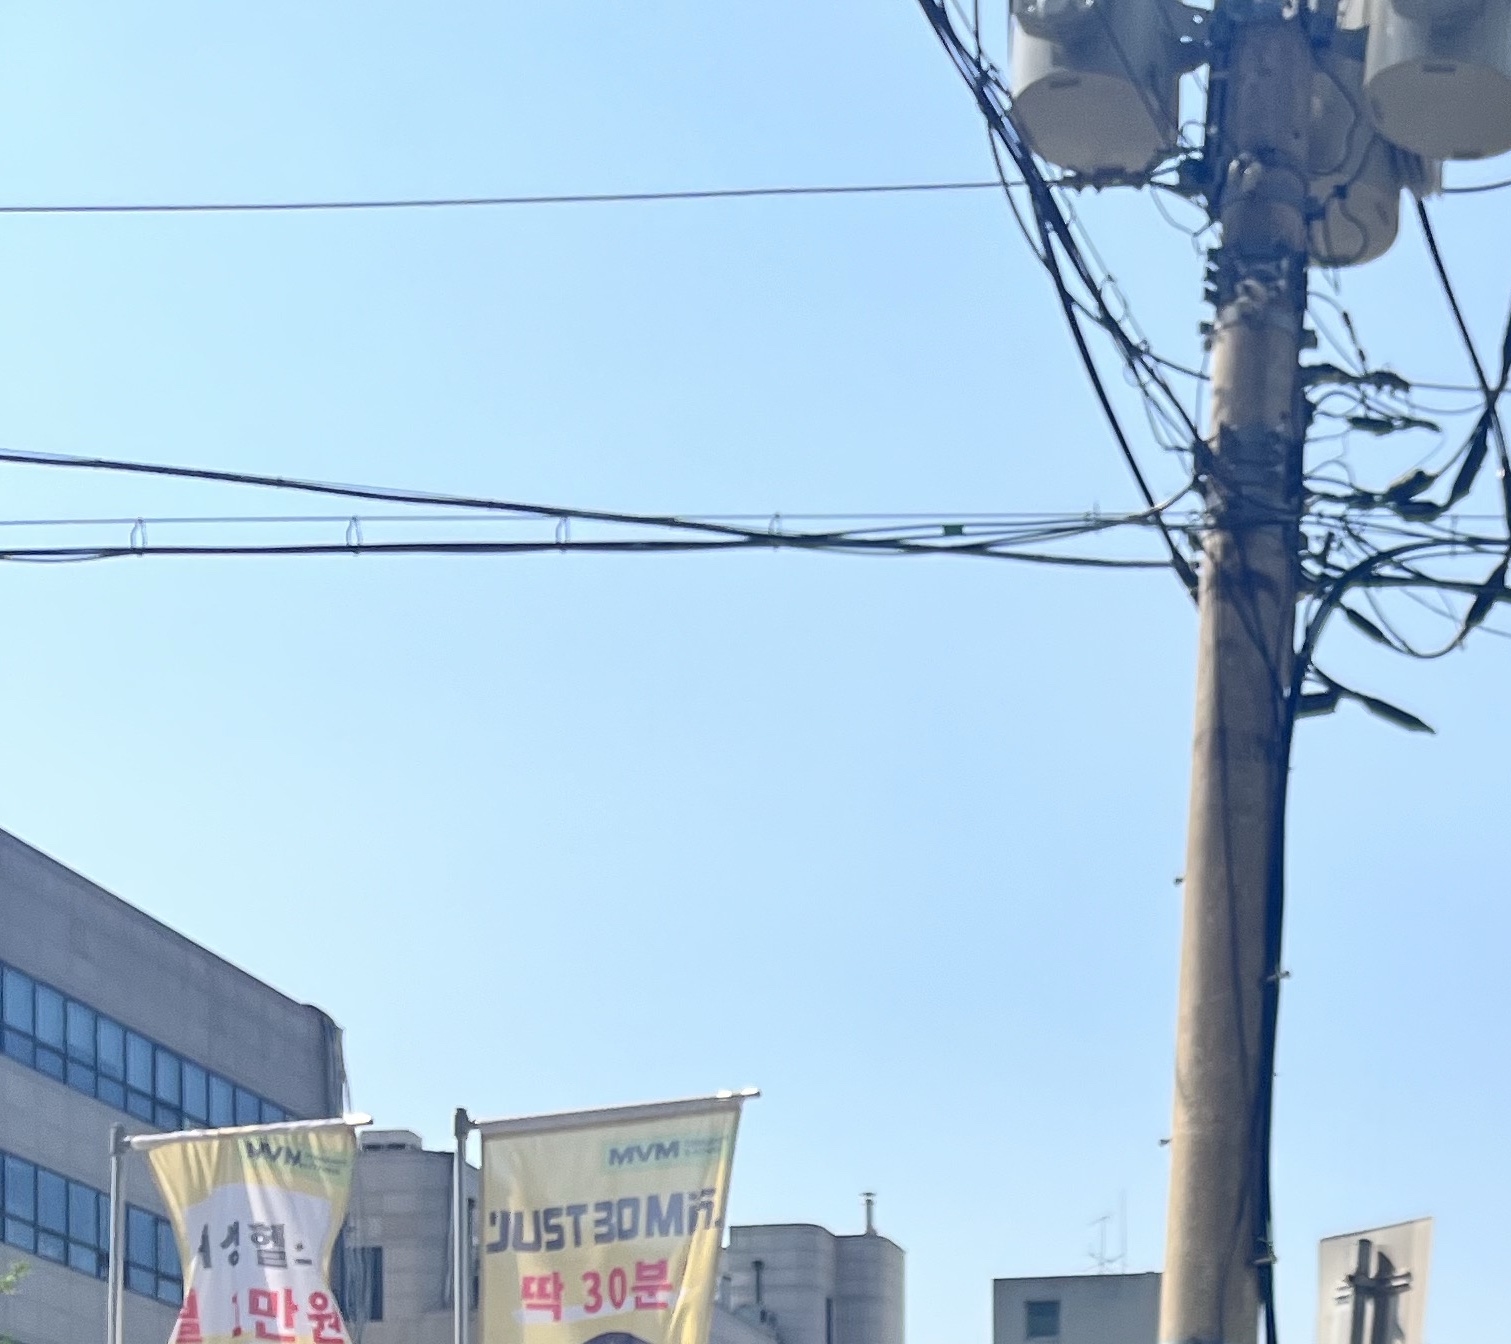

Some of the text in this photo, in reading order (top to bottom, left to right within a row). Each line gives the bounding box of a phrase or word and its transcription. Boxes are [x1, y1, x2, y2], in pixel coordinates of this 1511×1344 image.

[609, 1140, 680, 1166] MVM
[521, 1259, 673, 1322] 딱 30분
